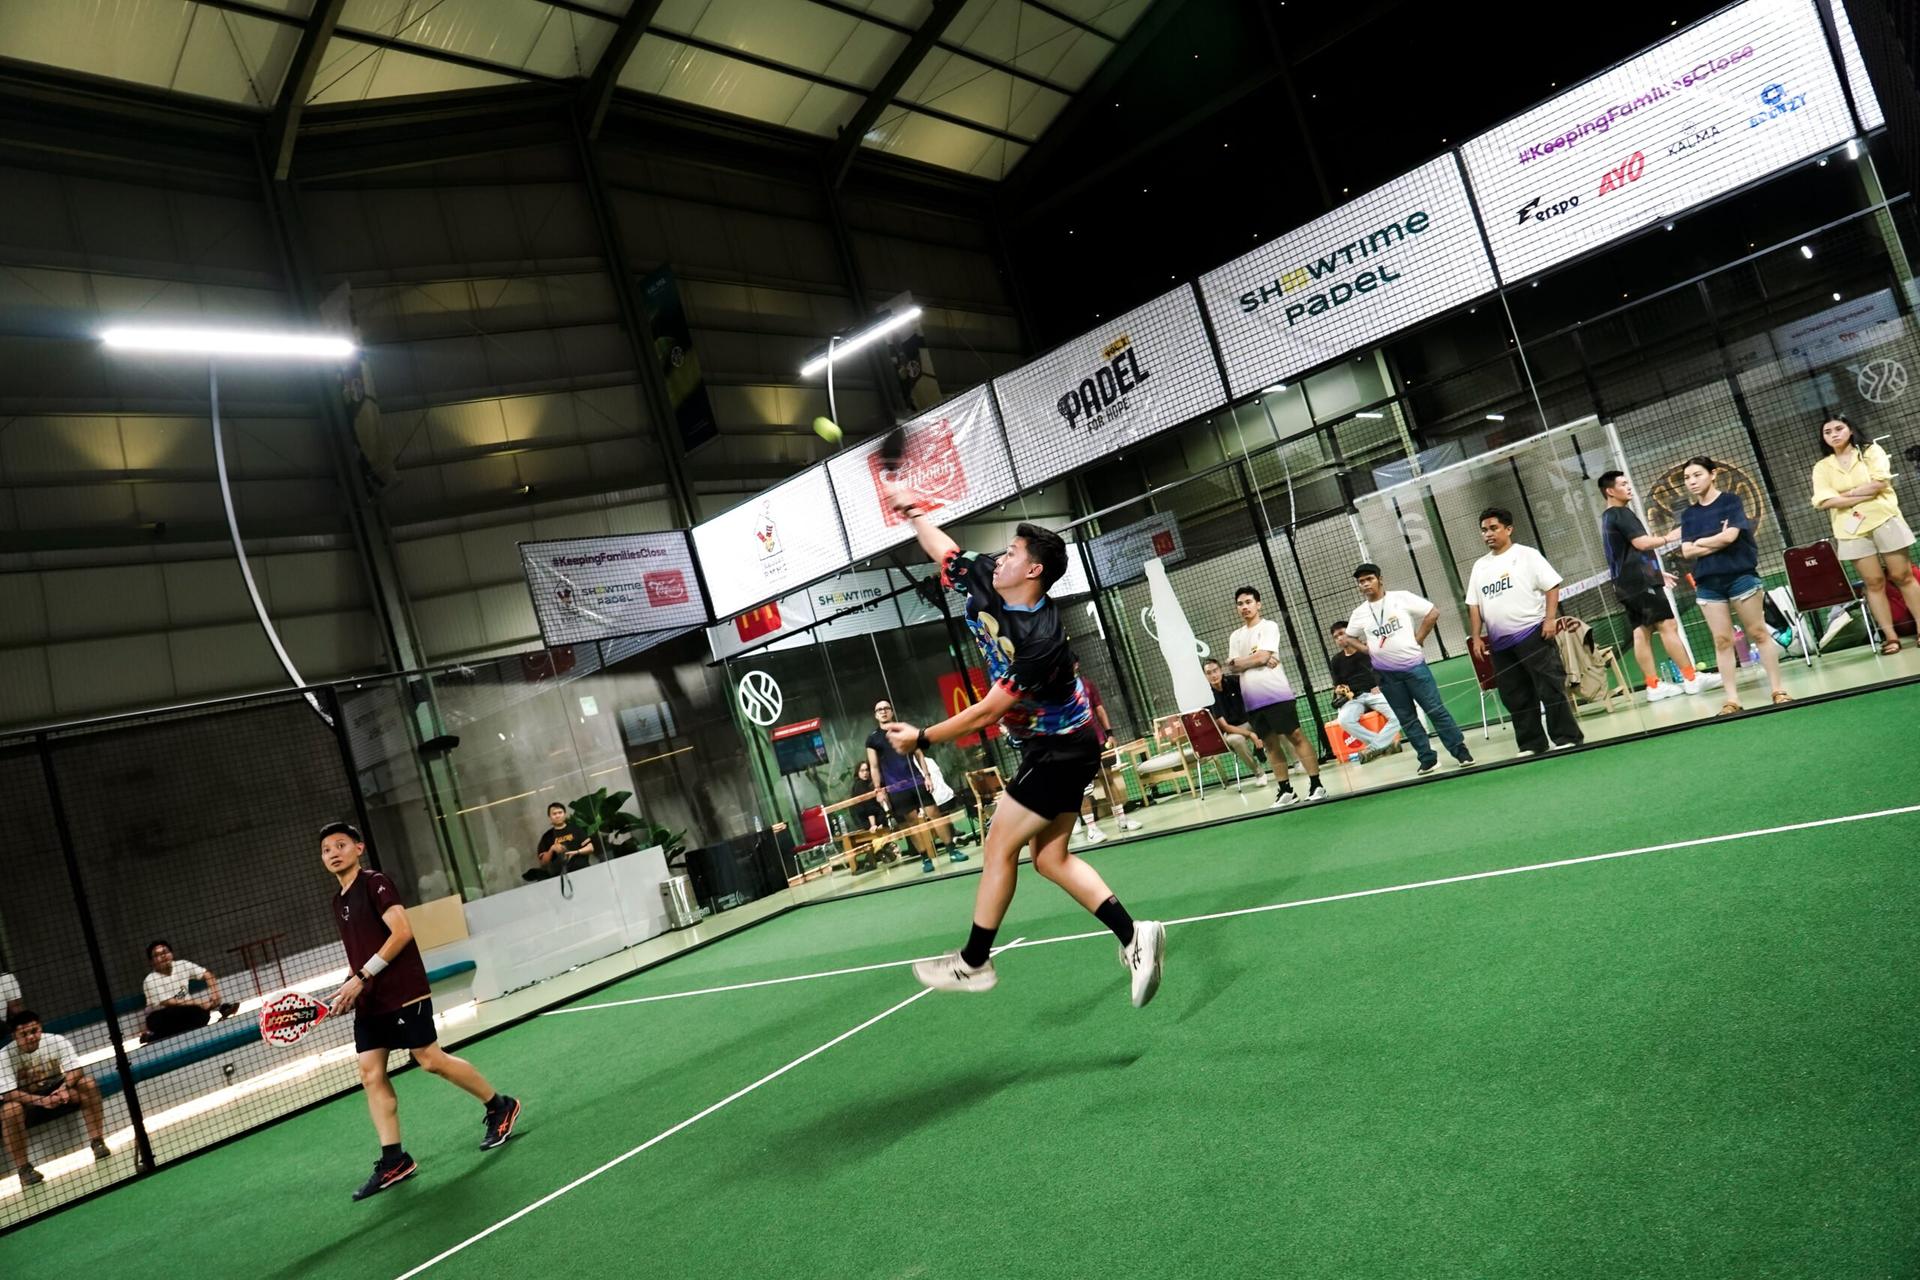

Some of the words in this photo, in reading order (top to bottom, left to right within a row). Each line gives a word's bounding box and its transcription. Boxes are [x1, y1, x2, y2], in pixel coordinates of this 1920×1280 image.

[1667, 126, 1721, 157] KALMA
[1597, 151, 1645, 197] AYO
[1057, 346, 1150, 430] PADEL
[1087, 415, 1105, 434] FOR
[1106, 397, 1130, 422] HOPE
[552, 547, 667, 567] #KeepingFamiliesClose
[1481, 575, 1513, 597] PADEL
